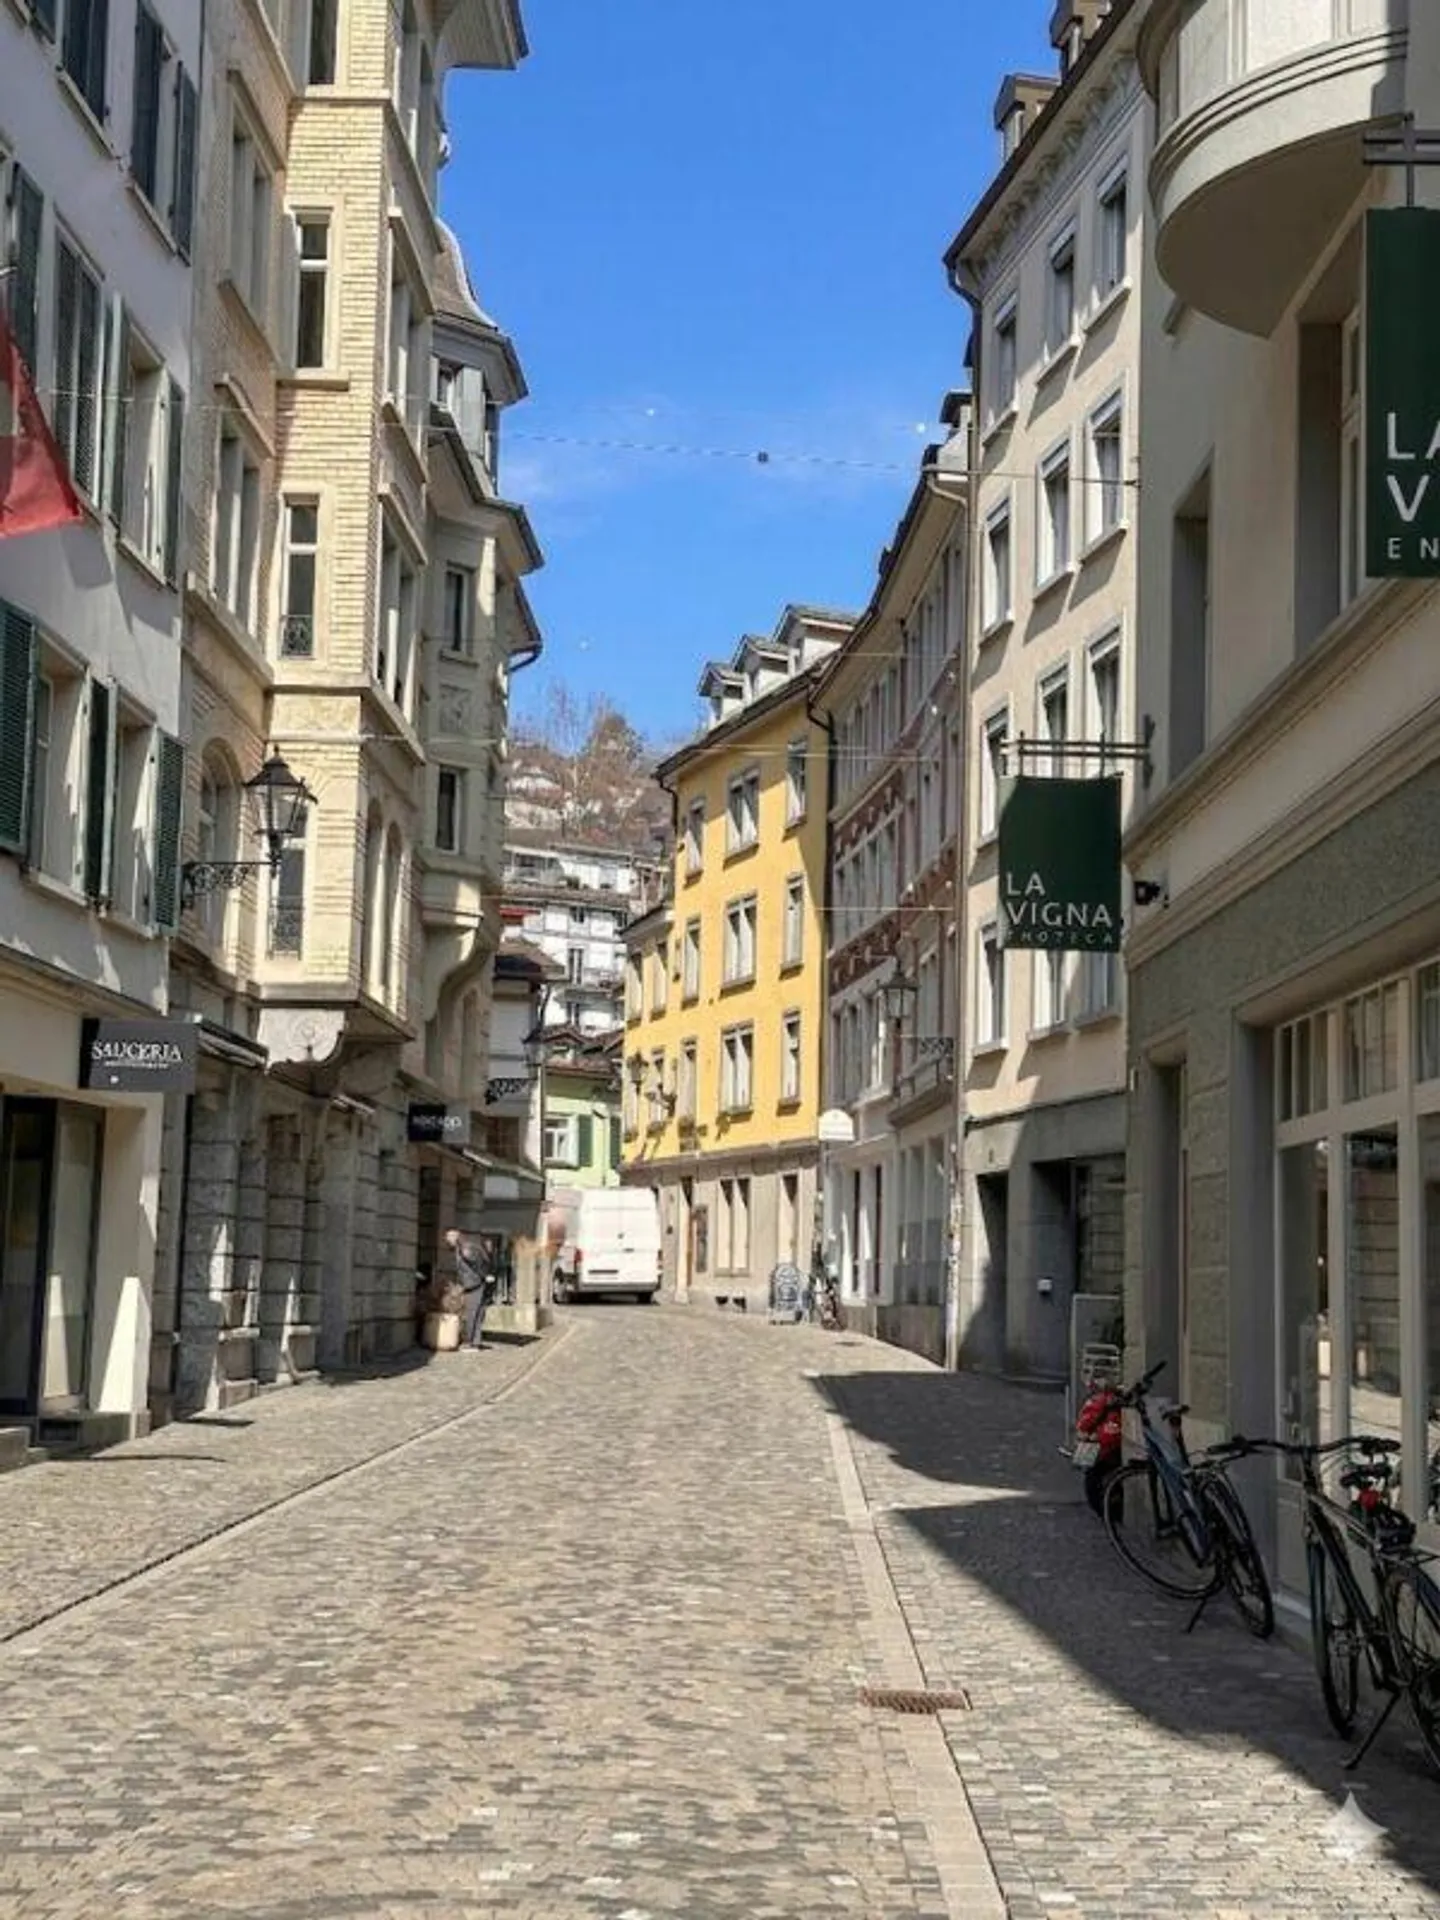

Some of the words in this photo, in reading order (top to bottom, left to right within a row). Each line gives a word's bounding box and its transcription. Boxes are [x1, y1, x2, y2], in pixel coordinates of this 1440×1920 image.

[1006, 872, 1046, 896] LA
[1006, 901, 1113, 927] VIGNA
[91, 1040, 183, 1061] SAUCERIA
